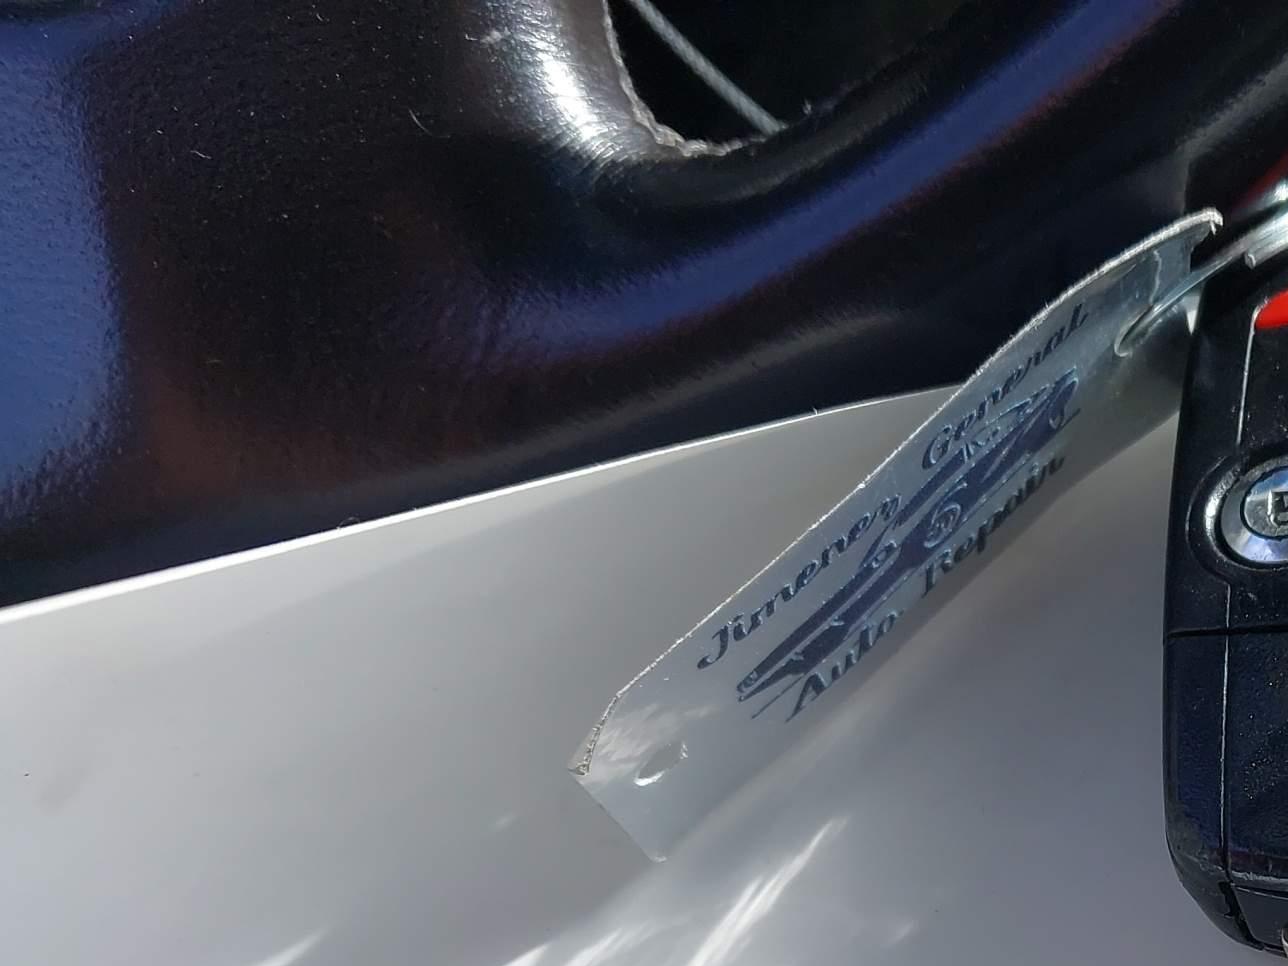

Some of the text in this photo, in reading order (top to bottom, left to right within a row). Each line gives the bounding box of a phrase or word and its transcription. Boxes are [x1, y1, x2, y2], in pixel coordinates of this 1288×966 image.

[697, 303, 1089, 669] Jimenez General
[785, 454, 1066, 722] Auto Repair
